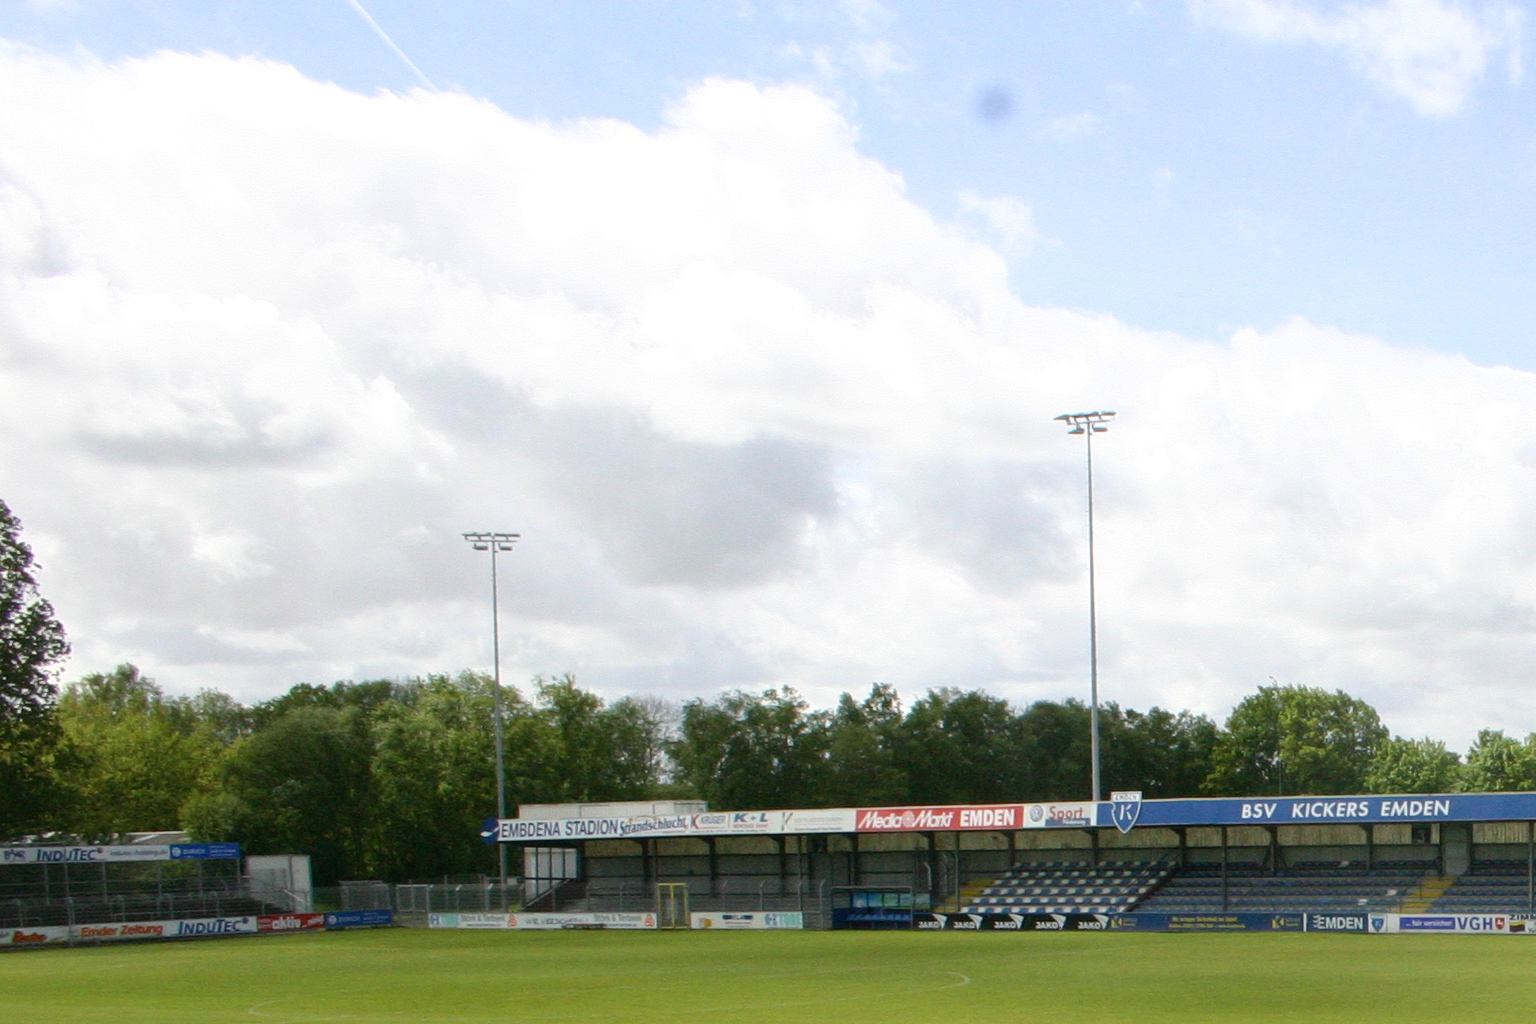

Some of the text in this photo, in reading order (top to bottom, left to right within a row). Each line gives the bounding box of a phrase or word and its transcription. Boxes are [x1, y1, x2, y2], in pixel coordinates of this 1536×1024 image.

[1048, 805, 1084, 822] Sport
[1119, 804, 1133, 821] K
[1240, 800, 1450, 819] BSV KICKERS EMDEN
[734, 813, 747, 823] K
[760, 812, 769, 823] L
[858, 811, 903, 829] Media
[912, 810, 955, 828] Markt
[959, 809, 1015, 827] EMDEN
[501, 819, 619, 838] EMBDENA STADION
[37, 848, 97, 862] INDUTEC
[179, 918, 241, 935] INDUTEC
[271, 916, 302, 930] aktiv
[917, 921, 940, 929] JAKO
[953, 921, 975, 929] JAKO
[993, 921, 1017, 929] JAKO
[1034, 921, 1058, 929] JAKO
[1077, 921, 1101, 929] JAKO
[1315, 917, 1363, 930] EMDEN
[1456, 917, 1493, 930] VGH
[81, 924, 164, 937] Emder Zeitung
